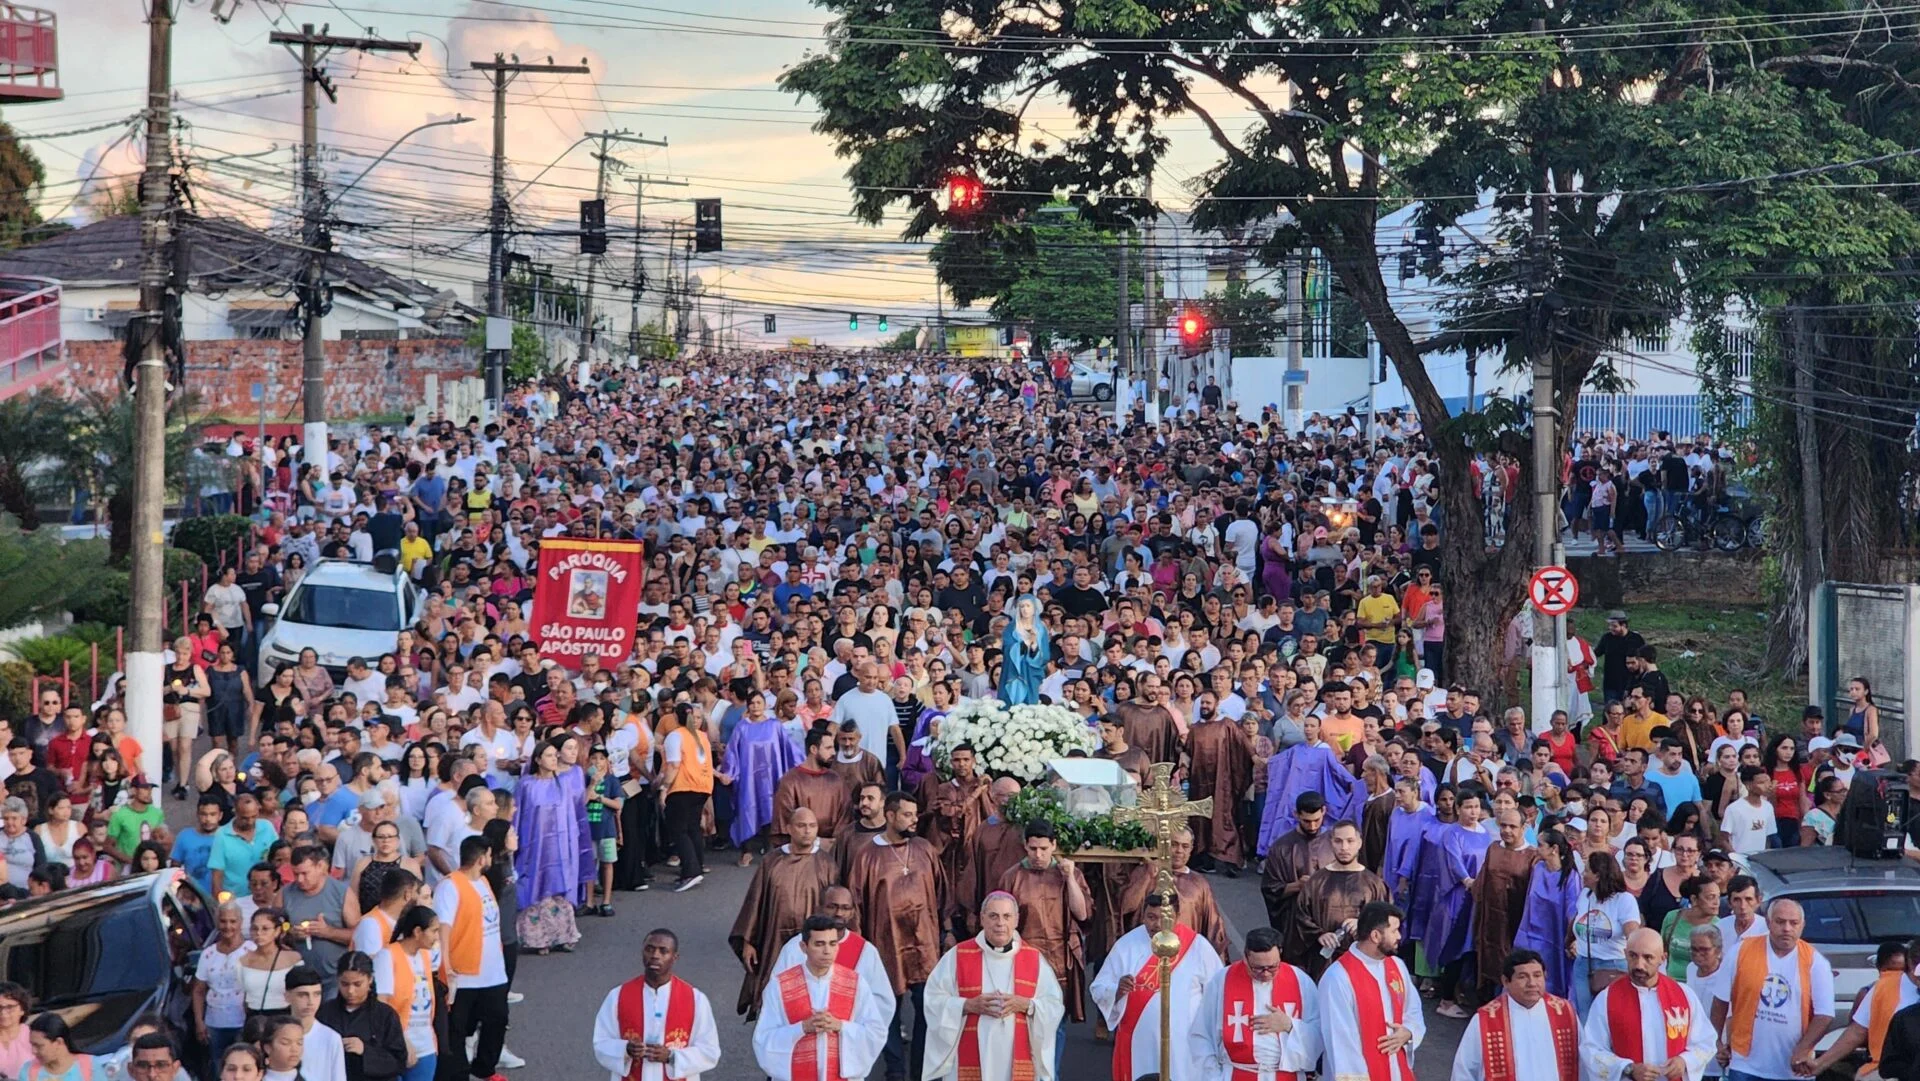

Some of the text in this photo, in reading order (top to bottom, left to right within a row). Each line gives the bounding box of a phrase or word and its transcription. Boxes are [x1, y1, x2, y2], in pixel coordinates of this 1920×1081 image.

[548, 550, 628, 584] PARÓQUIA
[540, 622, 625, 641] SÃO PAULO
[540, 640, 621, 657] APÓSTOLO
